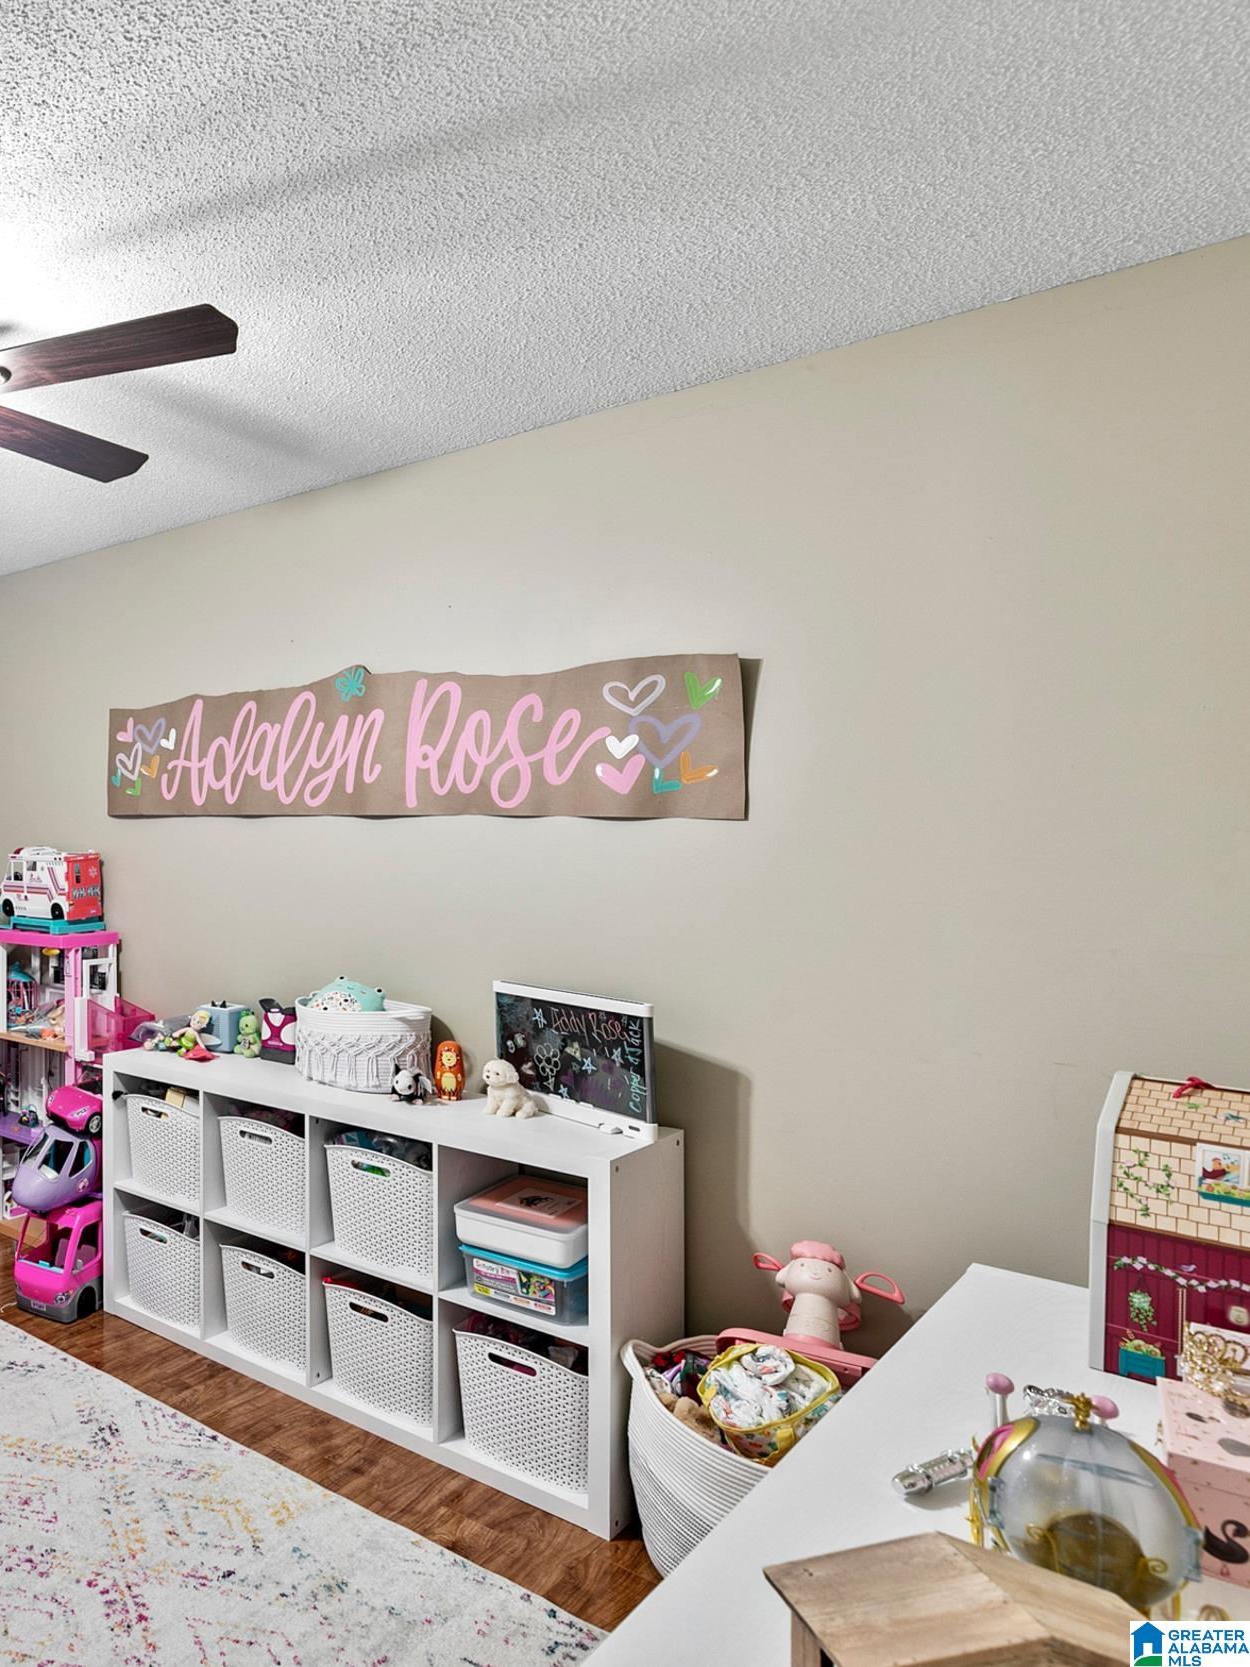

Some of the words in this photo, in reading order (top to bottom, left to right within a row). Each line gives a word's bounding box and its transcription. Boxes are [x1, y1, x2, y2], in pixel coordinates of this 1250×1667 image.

[161, 690, 385, 807] Adalyn
[406, 678, 611, 808] Rose
[550, 1006, 590, 1047] Addy
[589, 1012, 631, 1043] Rose
